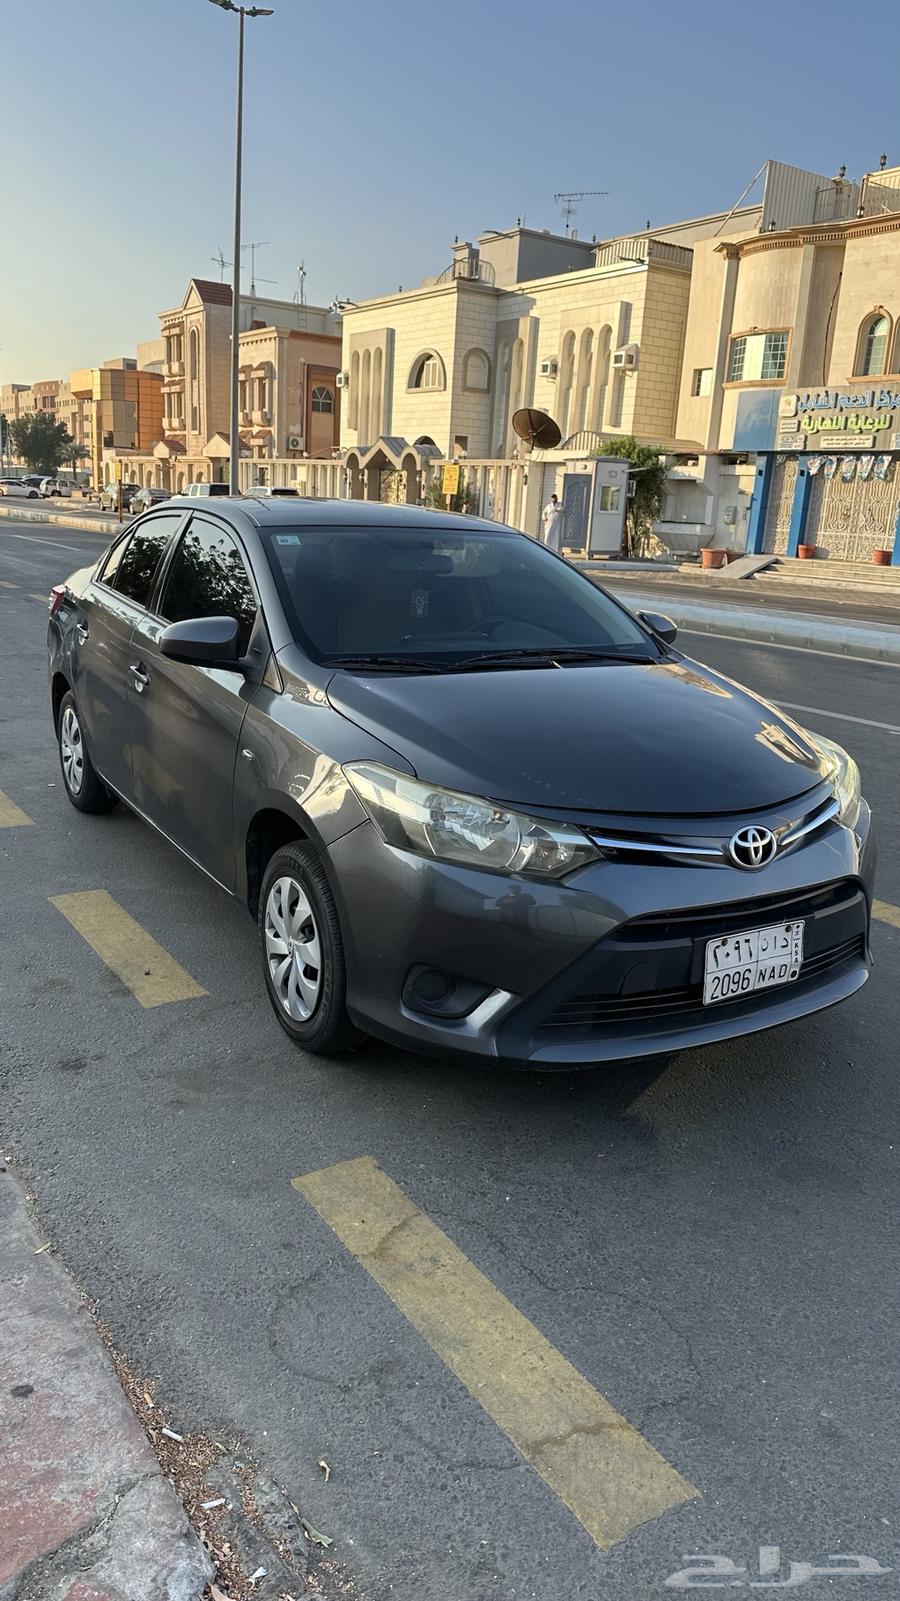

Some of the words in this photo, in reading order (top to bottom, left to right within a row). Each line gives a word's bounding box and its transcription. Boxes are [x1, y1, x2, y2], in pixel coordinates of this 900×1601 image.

[798, 390, 836, 412] الشامل
[838, 389, 873, 411] الدعم
[801, 414, 846, 434] النهارية
[848, 413, 891, 433] للرعاية
[713, 938, 752, 968] ٢٠٩٦
[711, 968, 752, 1000] 2096
[758, 964, 788, 983] NAD
